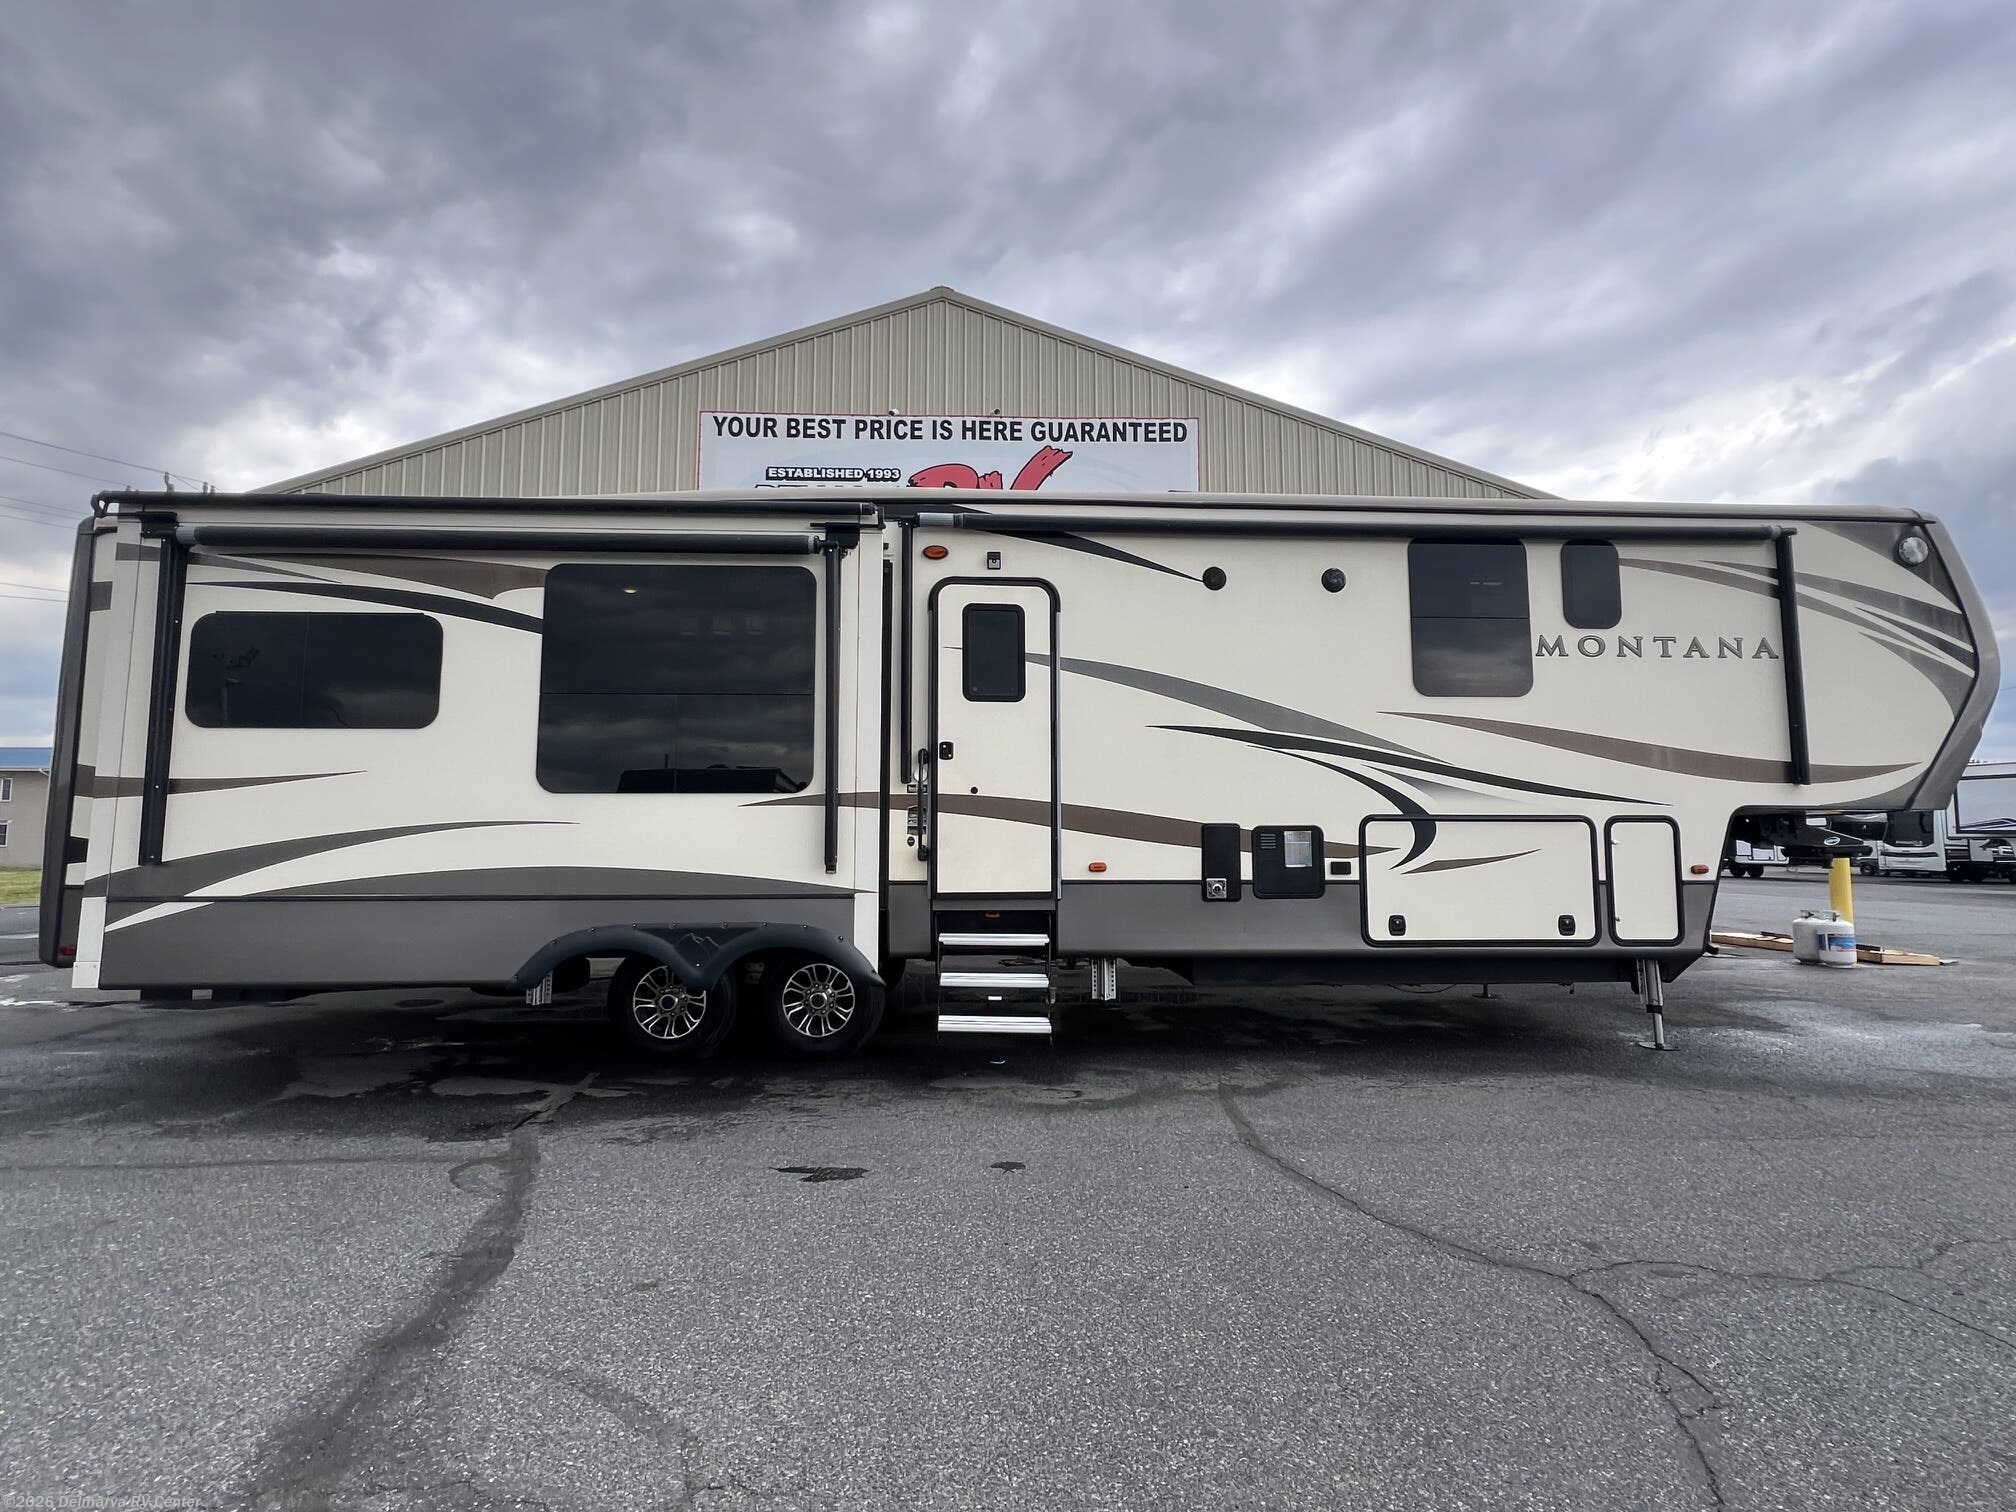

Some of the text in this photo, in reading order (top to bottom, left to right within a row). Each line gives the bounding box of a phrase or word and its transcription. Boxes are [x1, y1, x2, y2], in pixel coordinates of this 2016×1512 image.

[713, 416, 1188, 442] YOUR BEST PRICE IS HERE GUARANTEED
[767, 467, 901, 480] ESTABLISHED 1993
[1535, 634, 1780, 659] MONTANA
